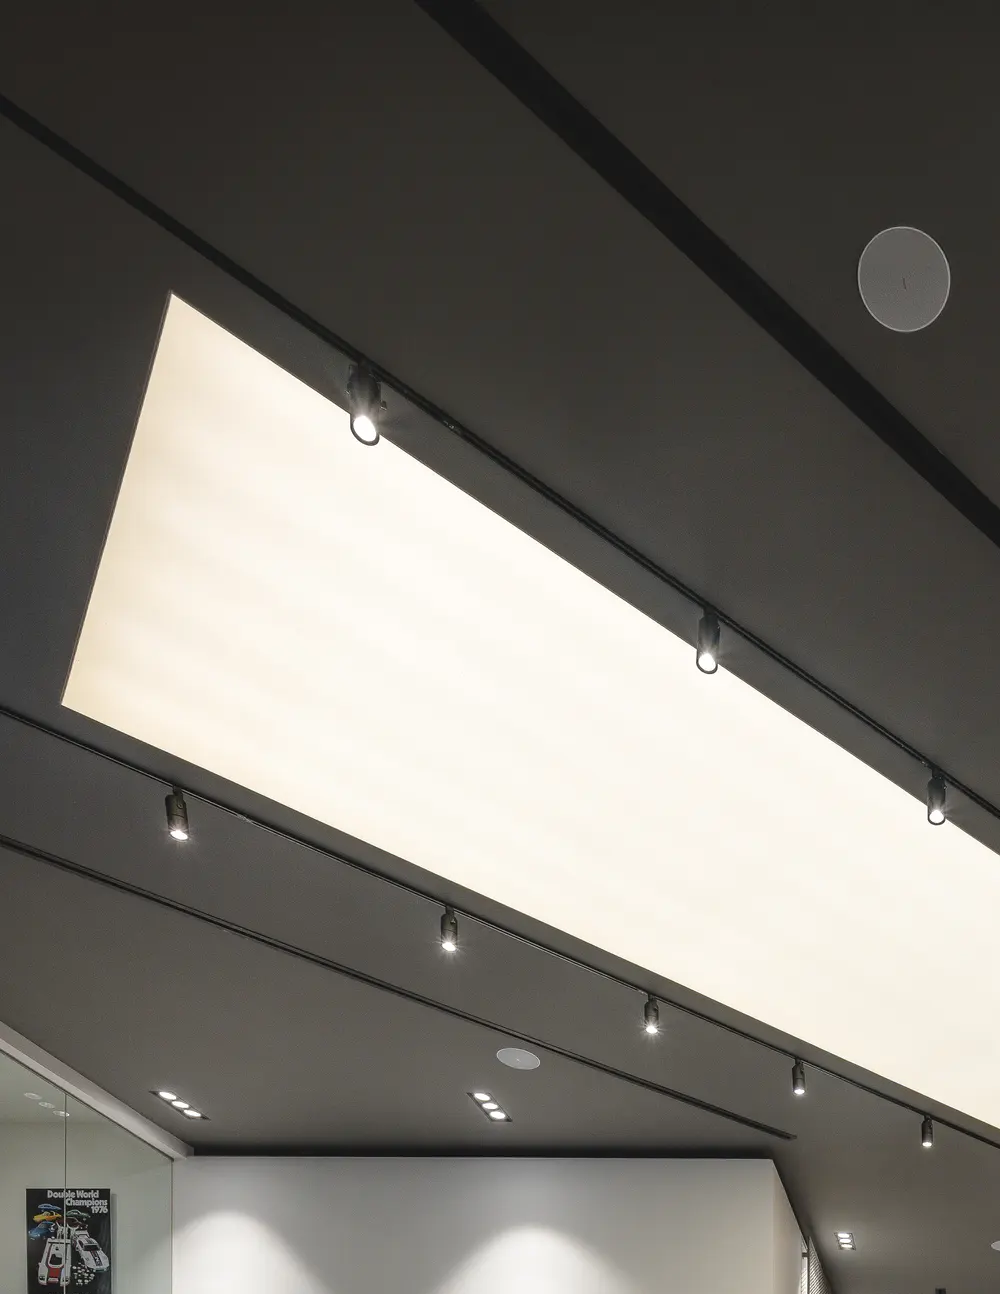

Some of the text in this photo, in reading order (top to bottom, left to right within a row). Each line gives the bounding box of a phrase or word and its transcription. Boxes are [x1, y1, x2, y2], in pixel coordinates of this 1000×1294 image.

[47, 1190, 99, 1199] Double World
[65, 1198, 108, 1208] Champions
[91, 1206, 108, 1214] 1976
